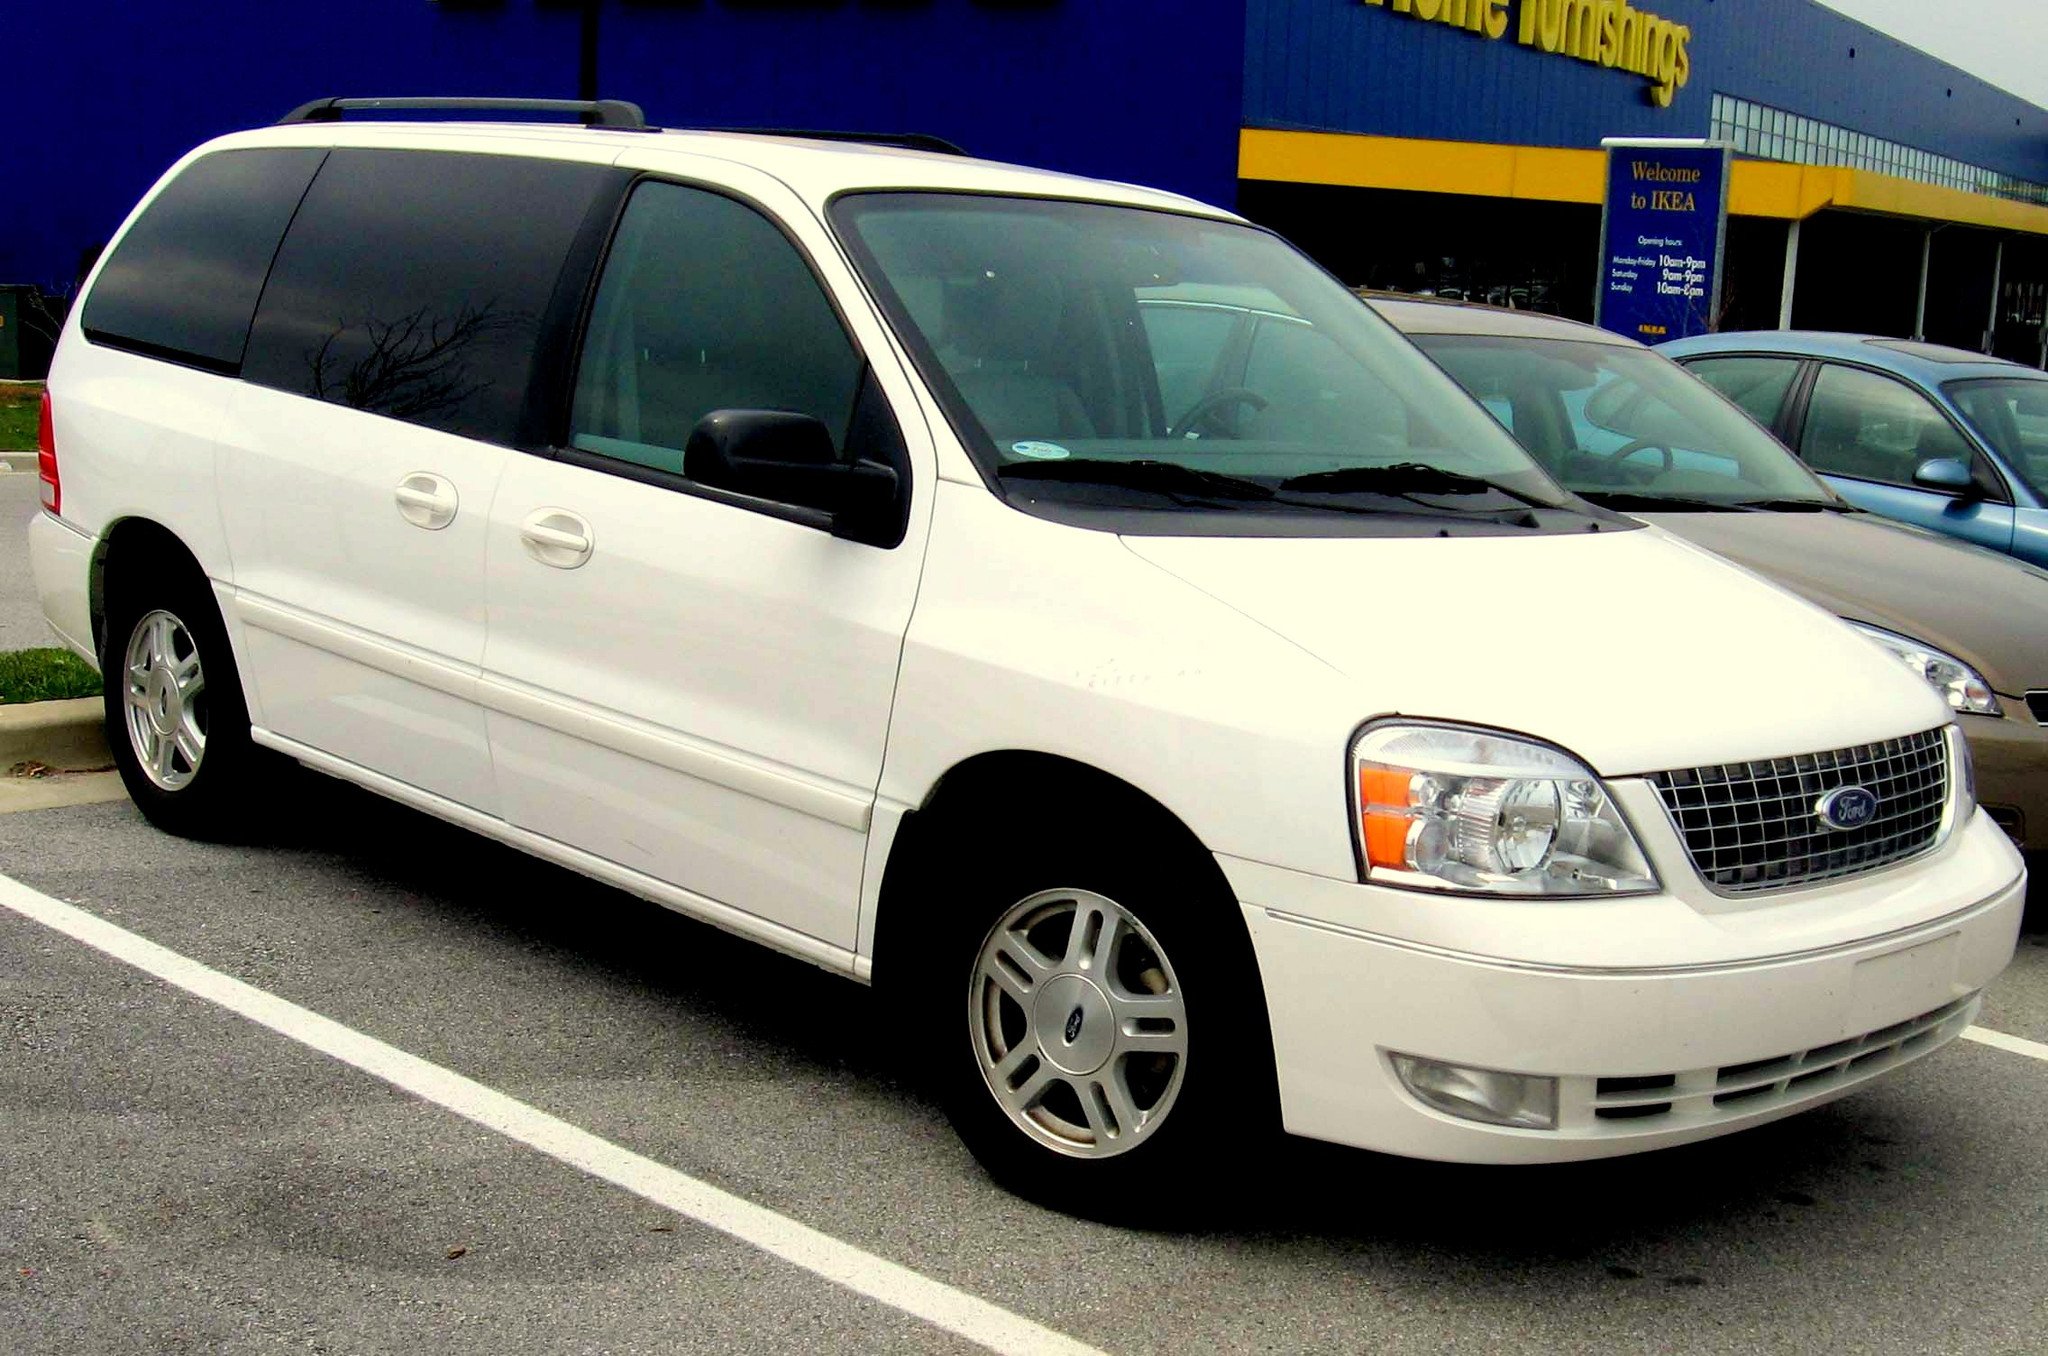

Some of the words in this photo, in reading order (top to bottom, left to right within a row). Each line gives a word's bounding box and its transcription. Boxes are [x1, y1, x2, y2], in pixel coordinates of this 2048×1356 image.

[1632, 161, 1700, 182] Welcome
[1631, 192, 1647, 209] to
[1651, 191, 1695, 211] IKEA
[1638, 235, 1664, 247] Opening
[1659, 254, 1706, 272] 10am-9pm
[1612, 268, 1638, 280] Saturday
[1662, 268, 1705, 285] 9am-9pm
[1611, 281, 1633, 293] Sunday
[1838, 796, 1866, 820] Ford
